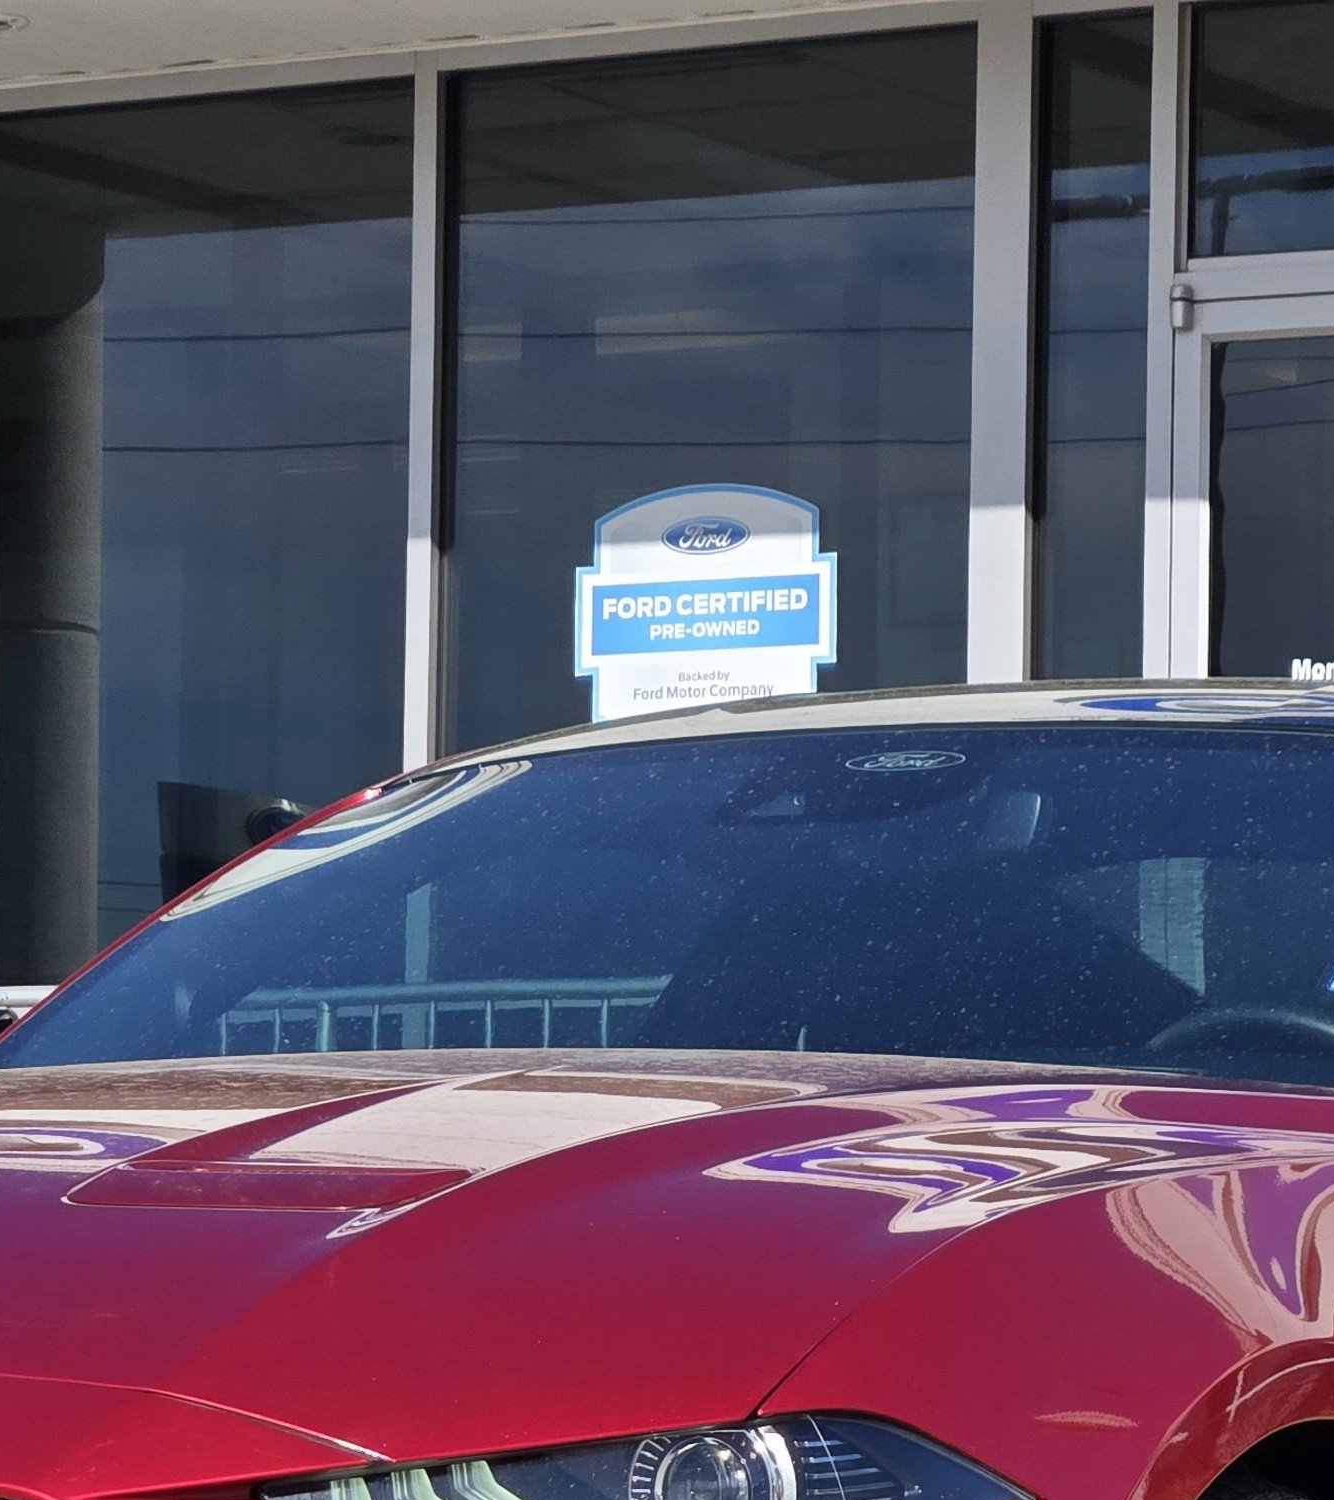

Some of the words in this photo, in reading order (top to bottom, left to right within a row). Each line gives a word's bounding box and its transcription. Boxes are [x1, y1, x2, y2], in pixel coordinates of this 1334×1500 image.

[679, 523, 732, 549] Ford
[602, 595, 672, 620] FORD
[676, 588, 808, 616] CERTIFIED
[650, 619, 760, 640] PRE-OWNED
[678, 672, 714, 682] Backed
[717, 671, 730, 681] by
[633, 687, 663, 700] Ford
[667, 686, 705, 699] Motor
[709, 684, 774, 698] Company
[864, 753, 946, 768] Ford
